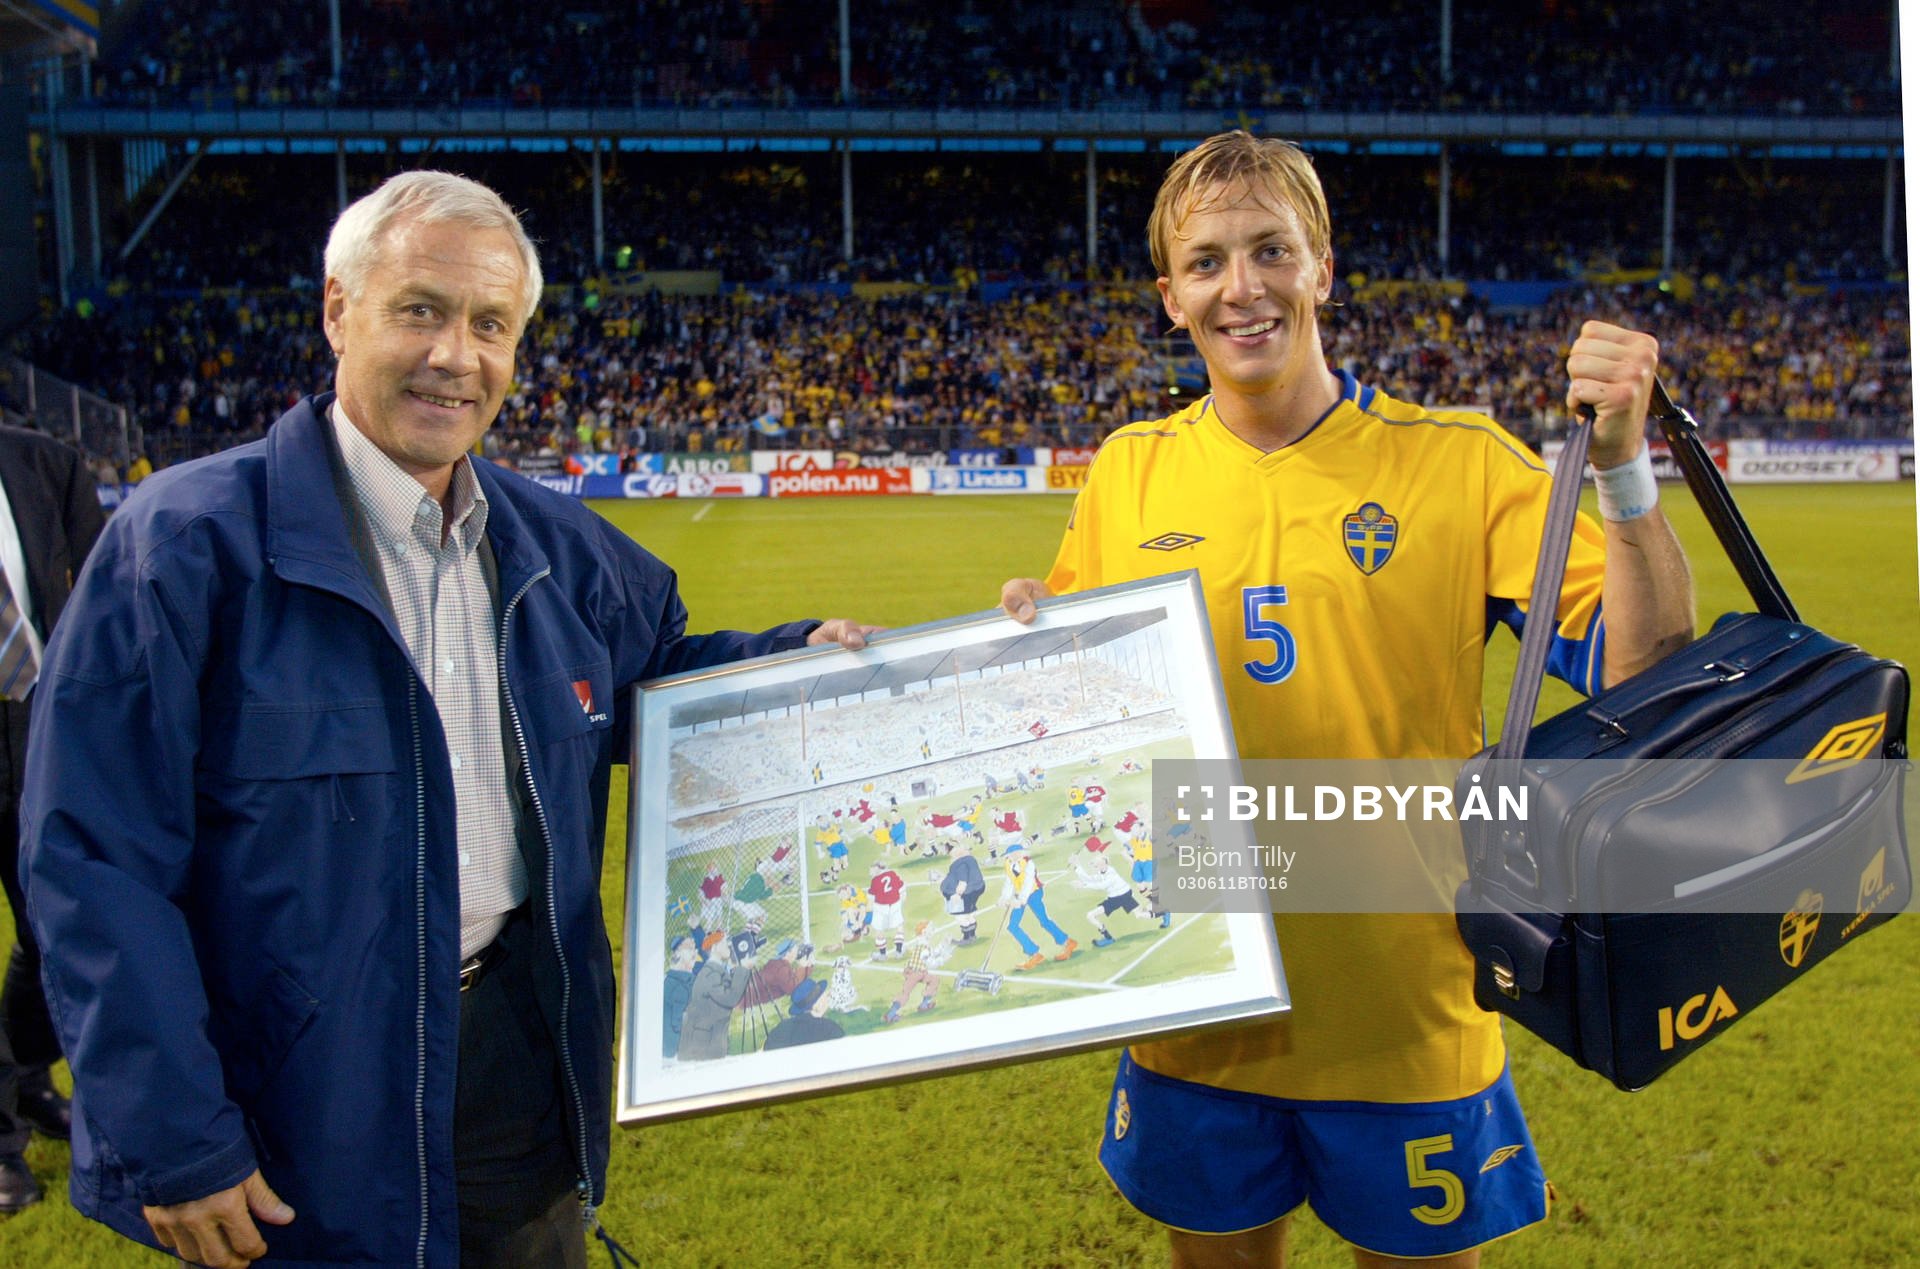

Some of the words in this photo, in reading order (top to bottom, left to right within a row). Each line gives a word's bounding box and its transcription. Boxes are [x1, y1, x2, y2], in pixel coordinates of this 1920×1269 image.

[770, 471, 880, 498] polen.nu
[777, 453, 817, 471] ICA
[1241, 585, 1297, 684] 5
[880, 876, 893, 893] 2
[1658, 984, 1739, 1050] ICA
[1405, 1133, 1465, 1226] 5
